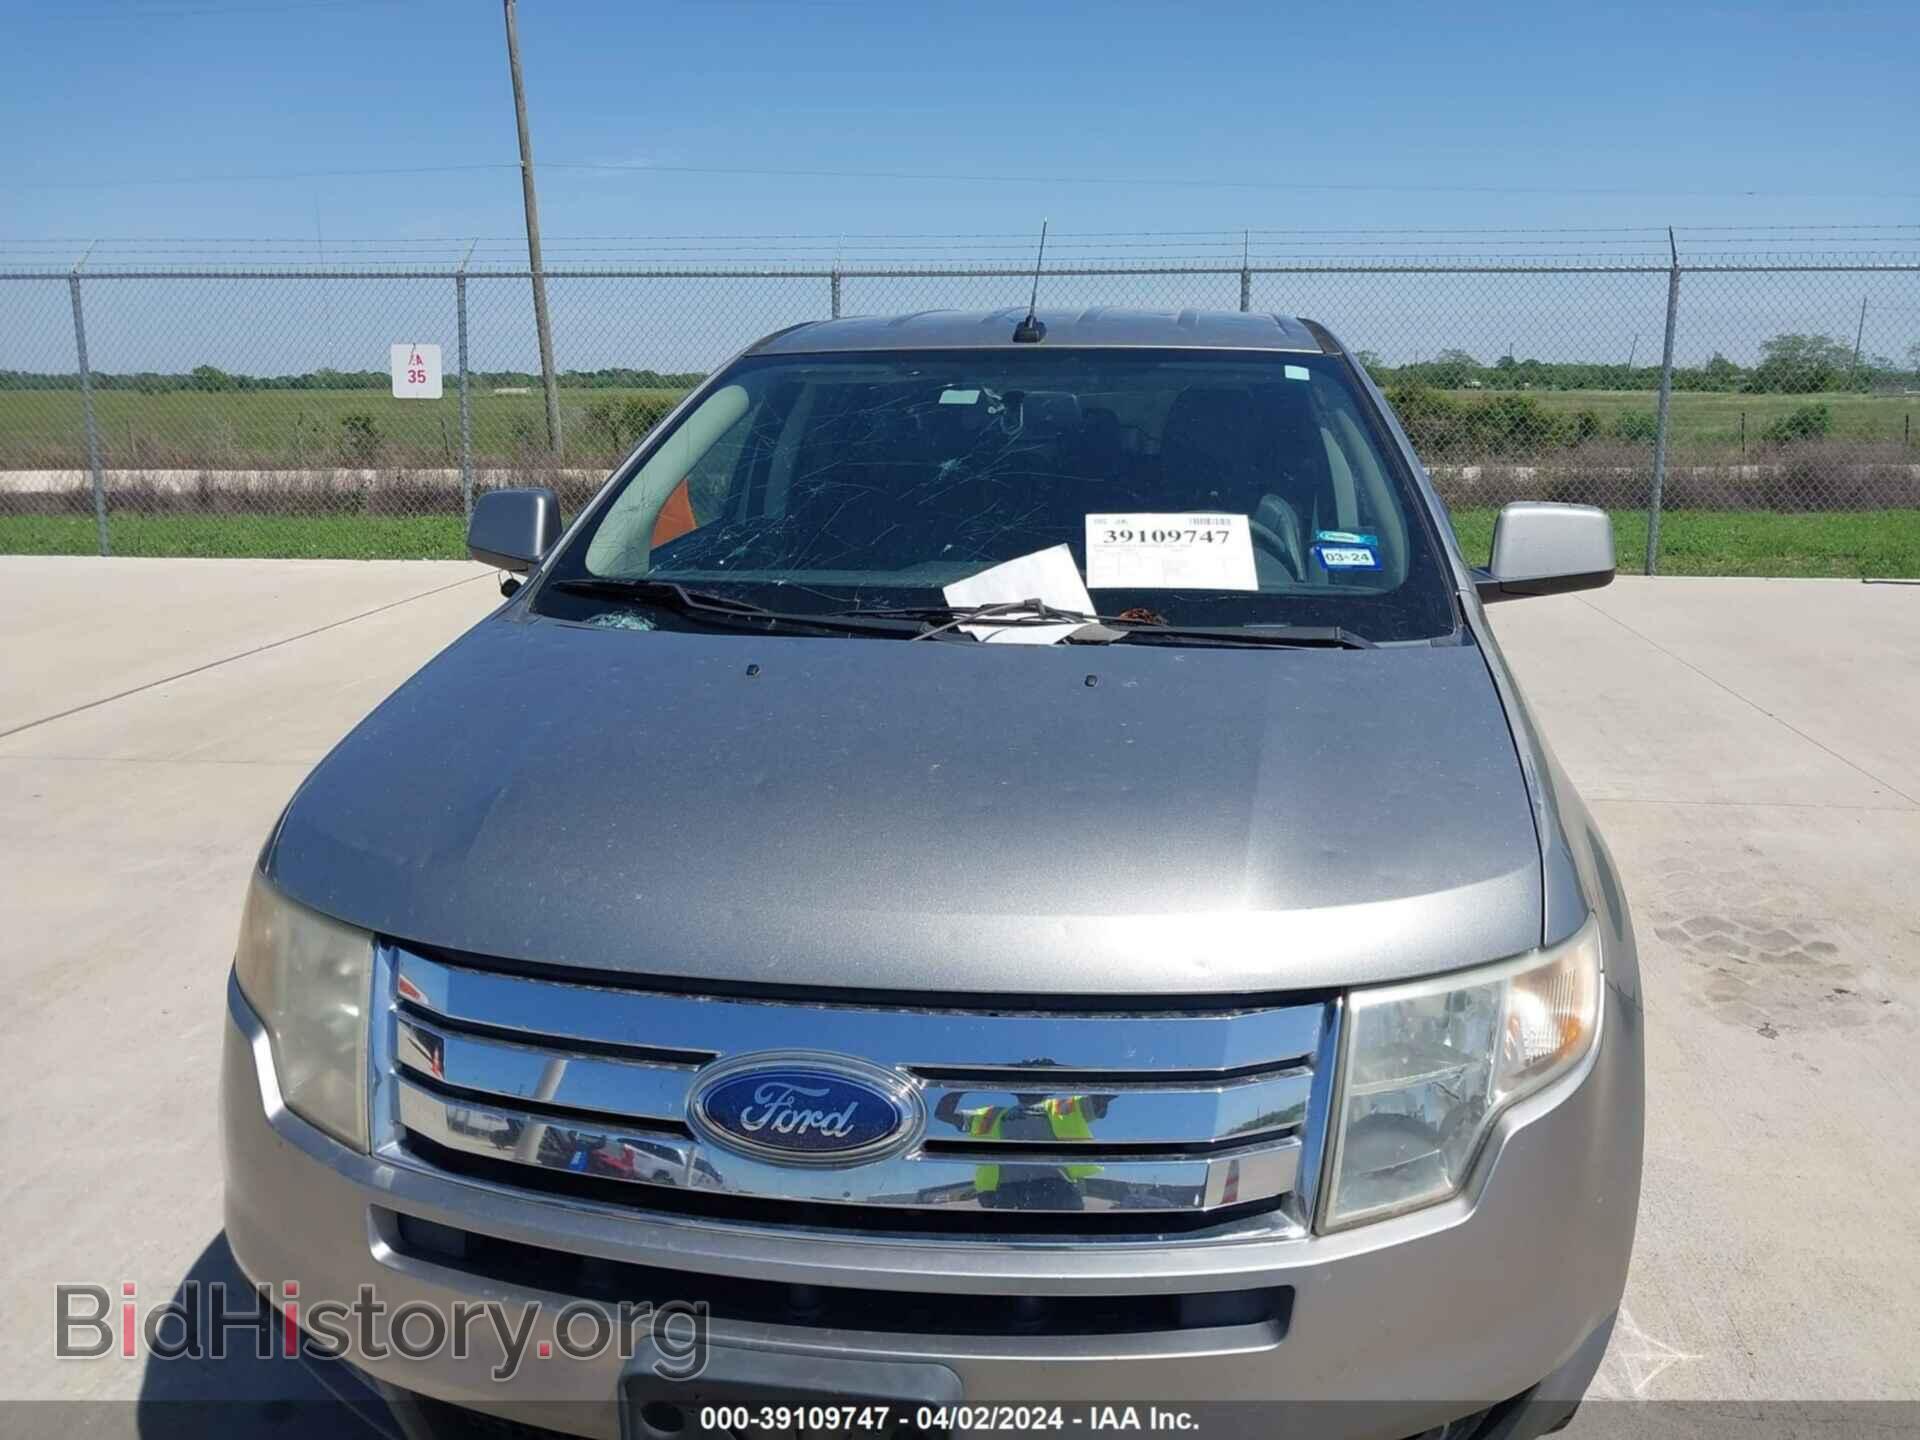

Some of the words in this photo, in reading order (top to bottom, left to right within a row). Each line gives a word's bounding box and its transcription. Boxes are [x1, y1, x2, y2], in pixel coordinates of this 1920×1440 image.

[407, 369, 427, 384] 35
[1103, 529, 1230, 544] 39109747
[1325, 552, 1370, 562] 03-24
[740, 1082, 859, 1139] Ford
